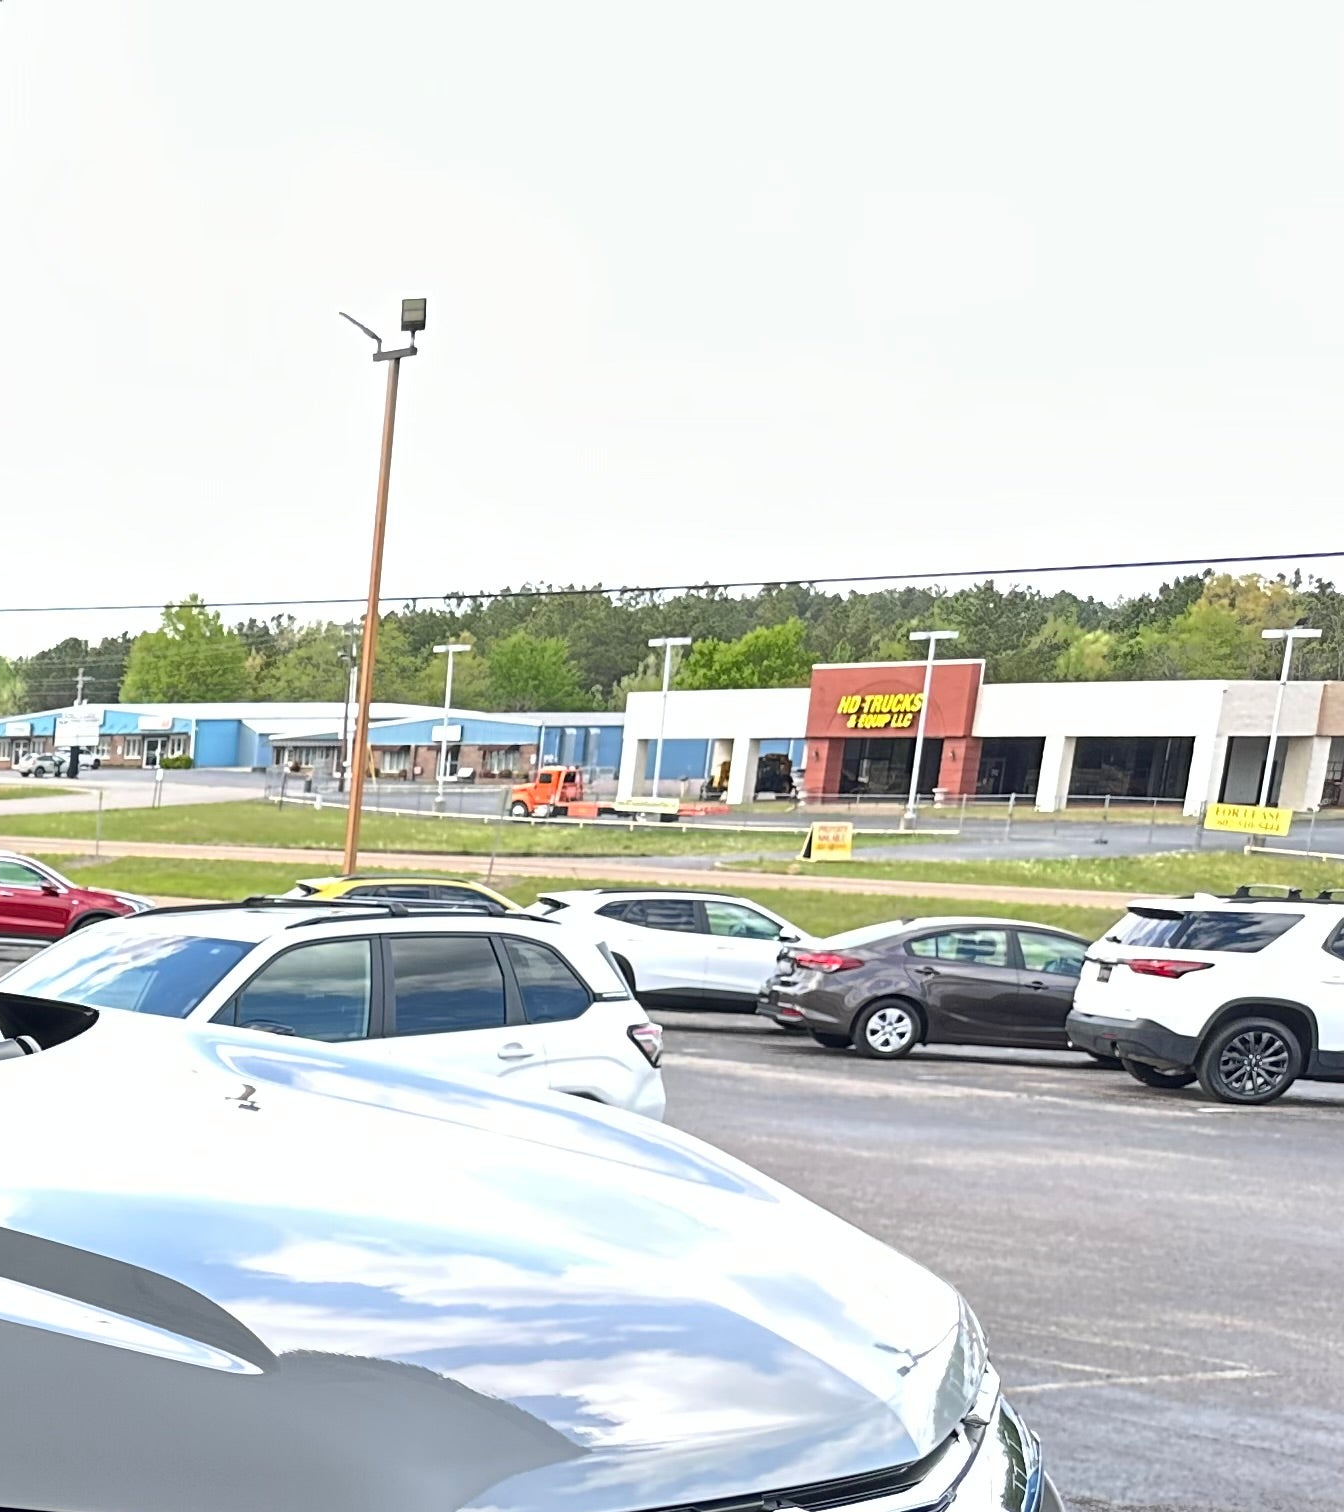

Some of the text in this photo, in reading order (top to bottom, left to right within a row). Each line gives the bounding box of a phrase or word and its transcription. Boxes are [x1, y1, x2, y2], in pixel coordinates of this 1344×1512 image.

[847, 713, 913, 729] & EQUIP LLC
[1215, 806, 1280, 820] FOR LEASE
